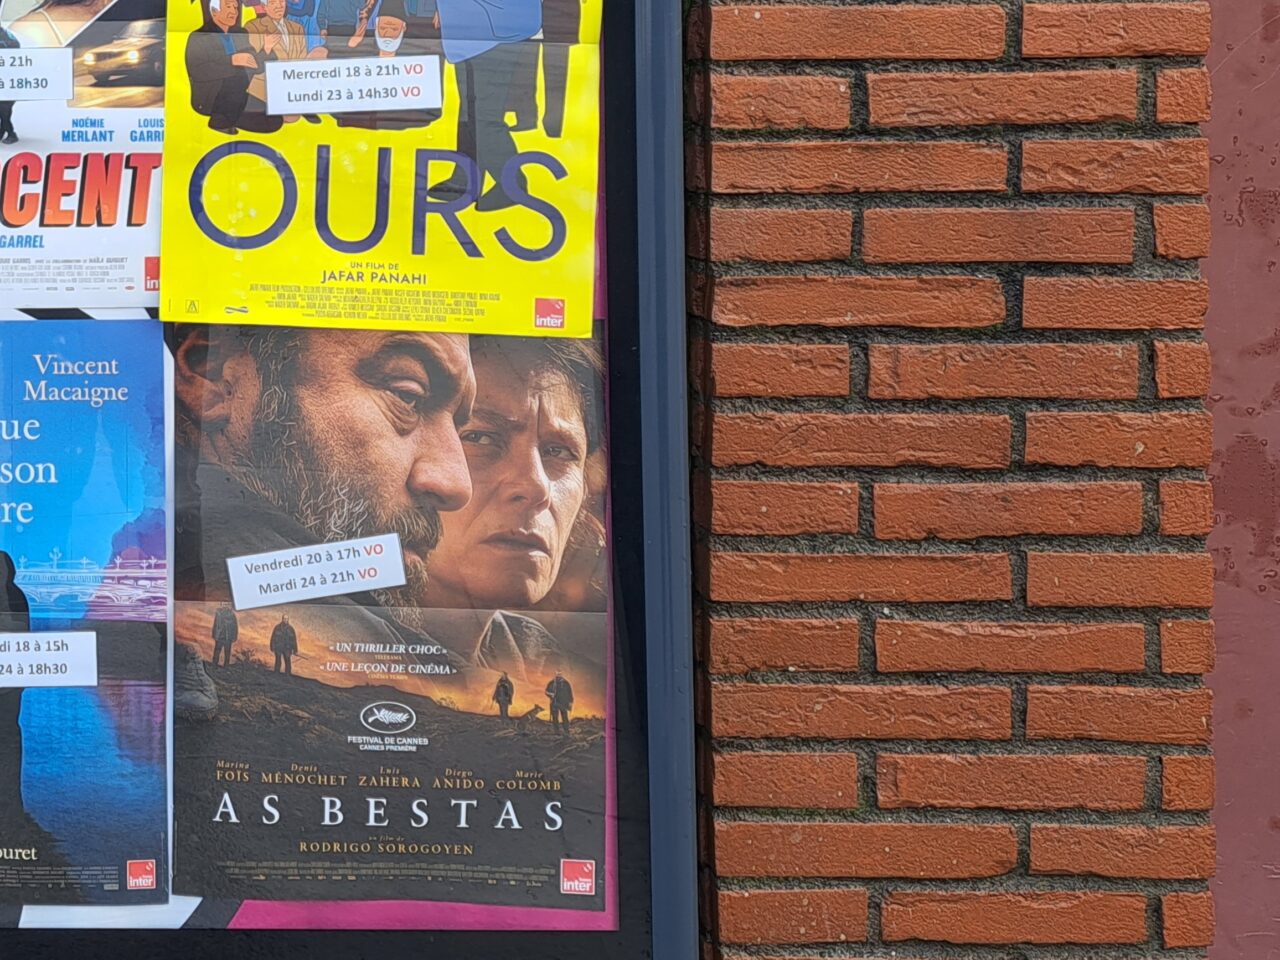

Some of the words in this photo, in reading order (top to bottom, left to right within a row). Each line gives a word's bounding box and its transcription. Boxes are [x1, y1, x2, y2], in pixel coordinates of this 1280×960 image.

[9, 56, 33, 67] 21h
[283, 67, 341, 80] Mercredi
[346, 66, 361, 77] 18
[364, 65, 372, 76] à
[376, 64, 400, 76] 21h
[404, 64, 423, 75] VO
[9, 78, 48, 89] 18h30
[287, 90, 322, 102] Lundi
[327, 90, 342, 101] 23
[346, 89, 354, 100] à
[358, 87, 397, 100] 14h30
[401, 86, 421, 97] VO
[72, 117, 105, 128] NOÉMIE
[62, 129, 114, 142] MERLANT
[188, 140, 570, 262] OURS
[320, 270, 365, 284] JAFAR
[370, 272, 427, 285] PANAHI
[535, 315, 563, 327] inter
[33, 354, 119, 376] Vincent
[23, 380, 129, 407] Macaigne
[244, 555, 303, 575] Vendredi
[306, 552, 322, 565] 20
[326, 550, 333, 562] à
[337, 547, 361, 560] 17h
[363, 544, 384, 556] VO
[258, 578, 297, 595] Mardi
[300, 576, 316, 588] 24
[320, 574, 327, 585] à
[331, 571, 355, 584] 21h
[358, 567, 378, 579] VO
[15, 641, 30, 652] 18
[34, 641, 41, 651] à
[46, 640, 69, 651] 15h
[17, 663, 24, 675] à
[28, 663, 68, 674] 18h30
[216, 770, 250, 783] FOÏS
[261, 771, 348, 786] MÉNOCHET
[358, 775, 421, 788] ZAHERA
[432, 778, 485, 790] ANIDO
[496, 779, 562, 791] COLOMB
[212, 792, 281, 825] AS
[321, 796, 563, 831] BESTAS
[299, 841, 371, 853] RODRIGO
[377, 842, 474, 856] SOROGOYEN
[562, 878, 593, 893] inter
